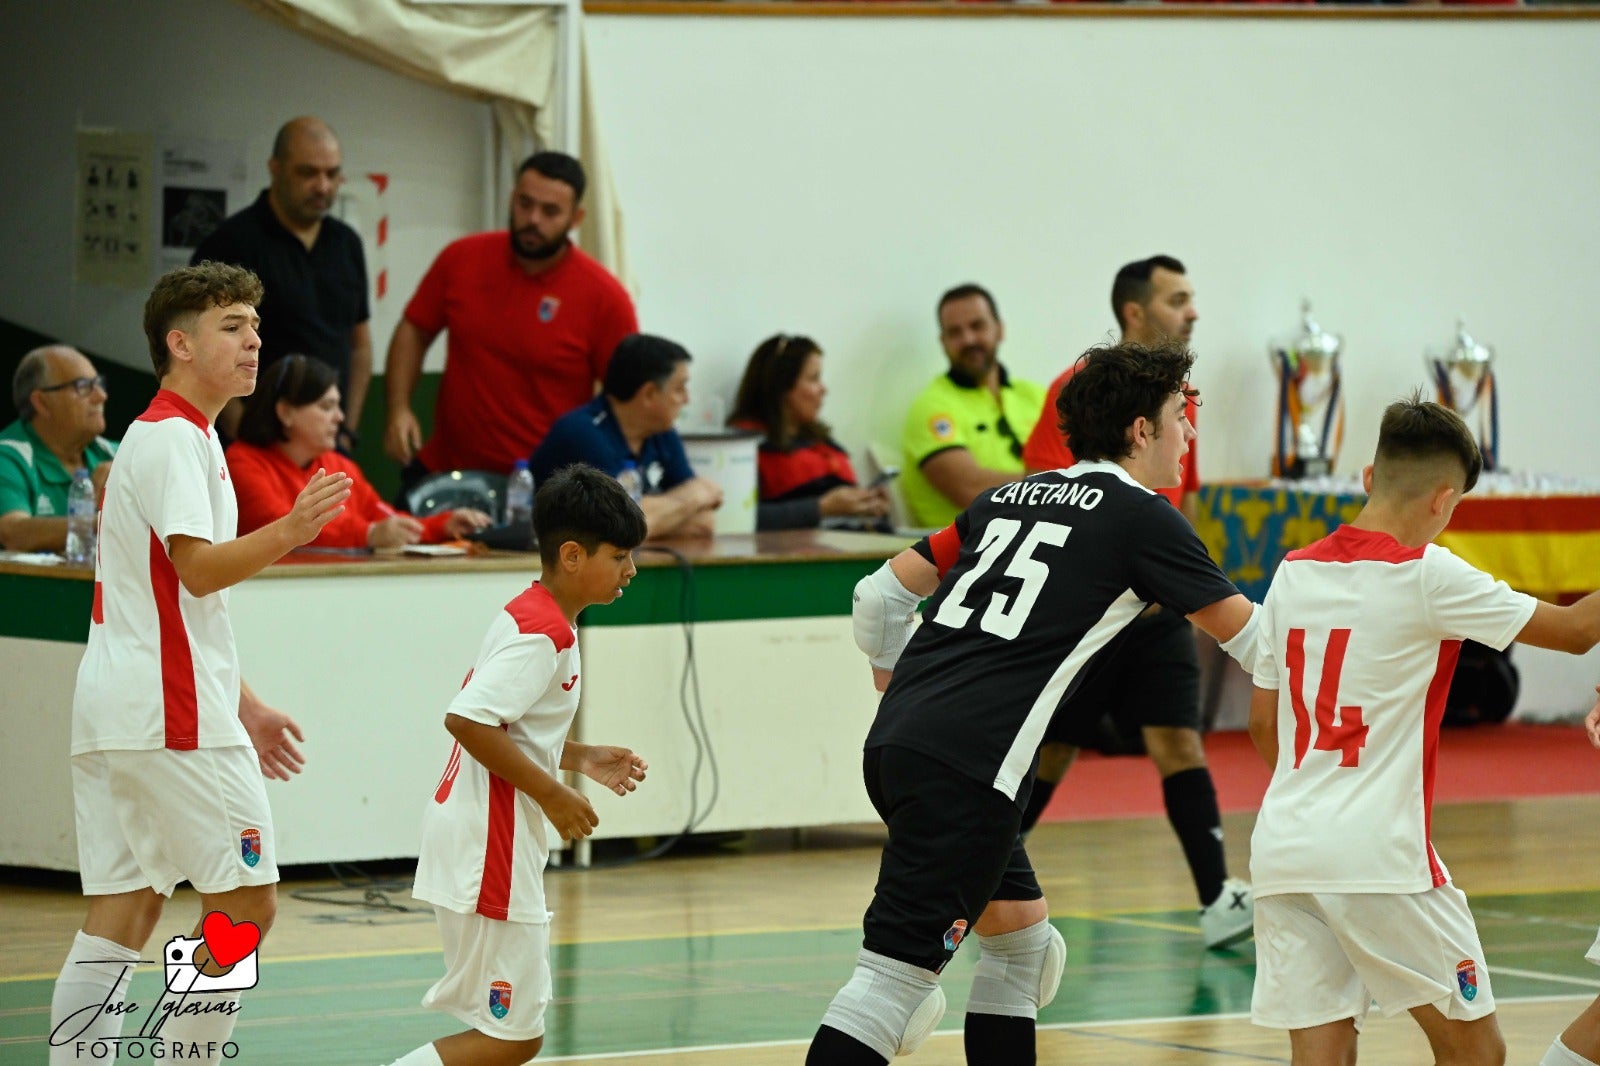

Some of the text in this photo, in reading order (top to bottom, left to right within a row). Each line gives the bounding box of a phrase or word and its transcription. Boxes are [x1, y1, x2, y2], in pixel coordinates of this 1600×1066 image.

[990, 481, 1105, 511] CAYETANO
[933, 517, 1072, 641] 25
[1286, 628, 1370, 769] 14
